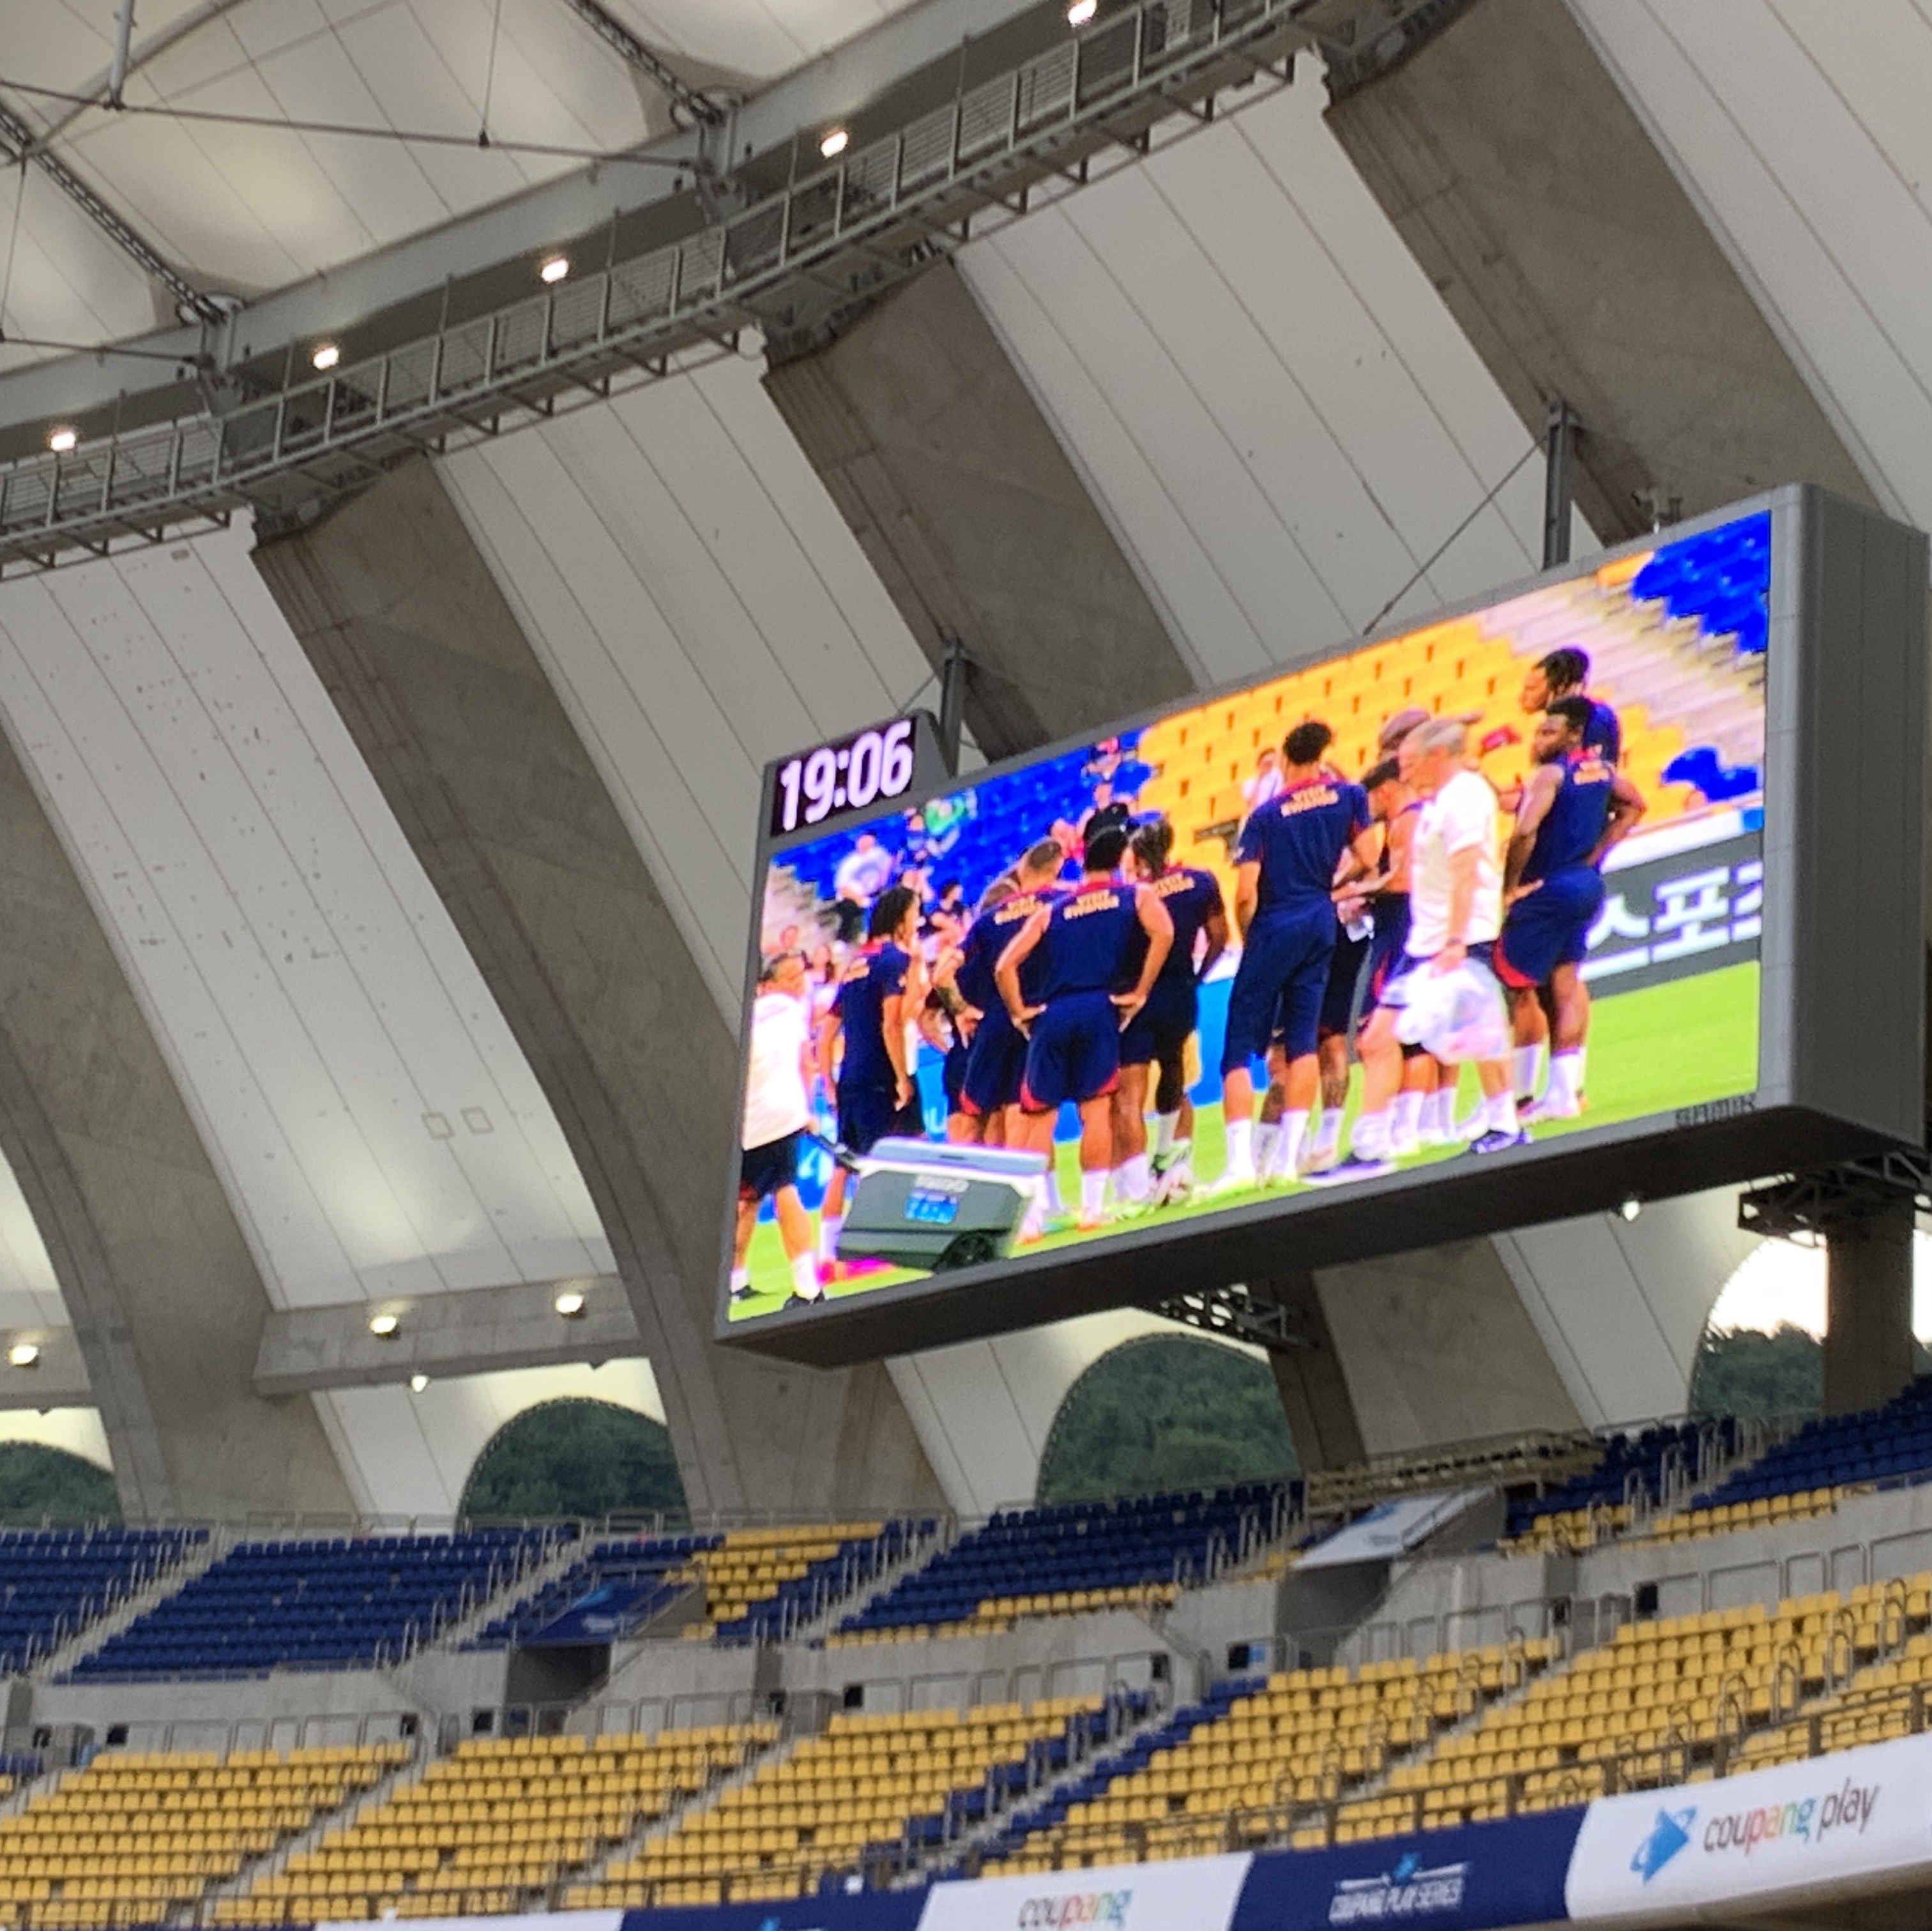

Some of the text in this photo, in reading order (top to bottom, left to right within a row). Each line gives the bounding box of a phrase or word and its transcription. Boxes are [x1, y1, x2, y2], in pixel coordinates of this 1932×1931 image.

[780, 720, 913, 831] 19:06
[1703, 1777, 1880, 1856] coupang play
[1017, 1889, 1132, 1931] coupang
